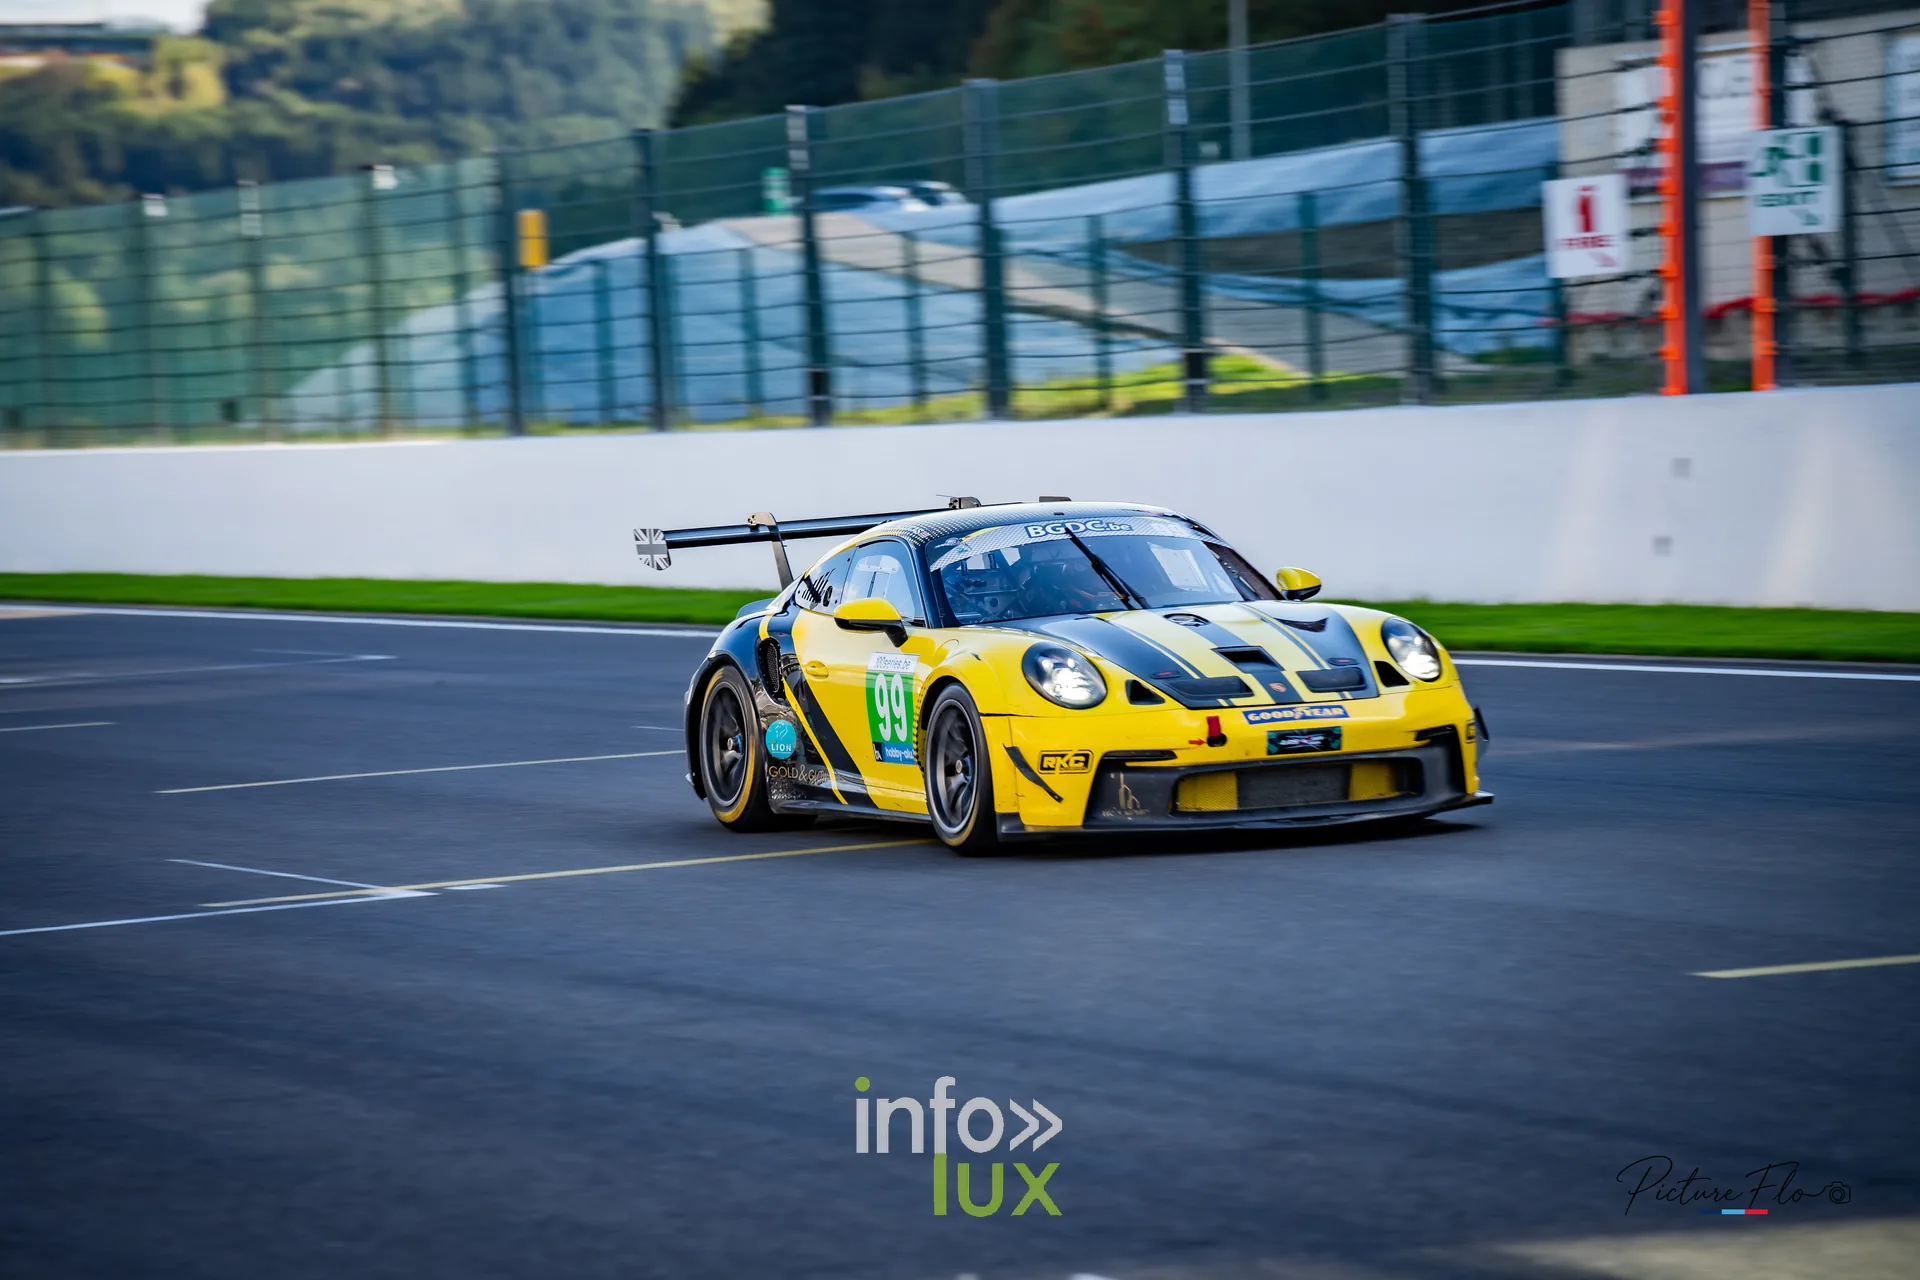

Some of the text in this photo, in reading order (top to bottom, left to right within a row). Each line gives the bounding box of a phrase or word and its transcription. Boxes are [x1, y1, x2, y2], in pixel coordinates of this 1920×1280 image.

[1024, 520, 1133, 538] BGDC.be
[874, 673, 907, 742] 99
[1247, 707, 1344, 721] GOODYEAR
[771, 743, 792, 752] LION
[1043, 755, 1086, 768] RKC
